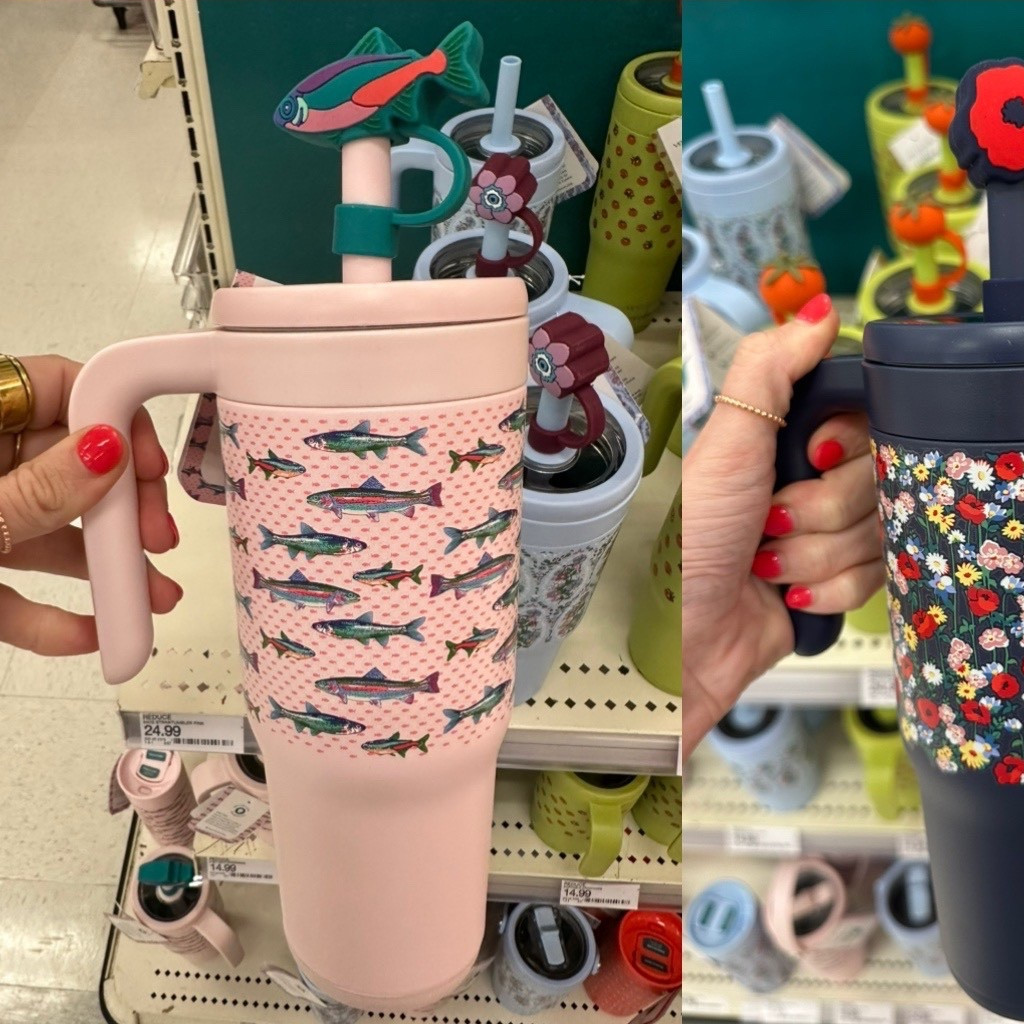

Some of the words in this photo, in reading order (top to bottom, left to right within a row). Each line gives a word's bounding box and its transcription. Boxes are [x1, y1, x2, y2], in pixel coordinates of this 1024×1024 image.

[144, 724, 181, 737] 24.99
[210, 863, 237, 872] 14.99
[564, 889, 592, 898] 14.99
